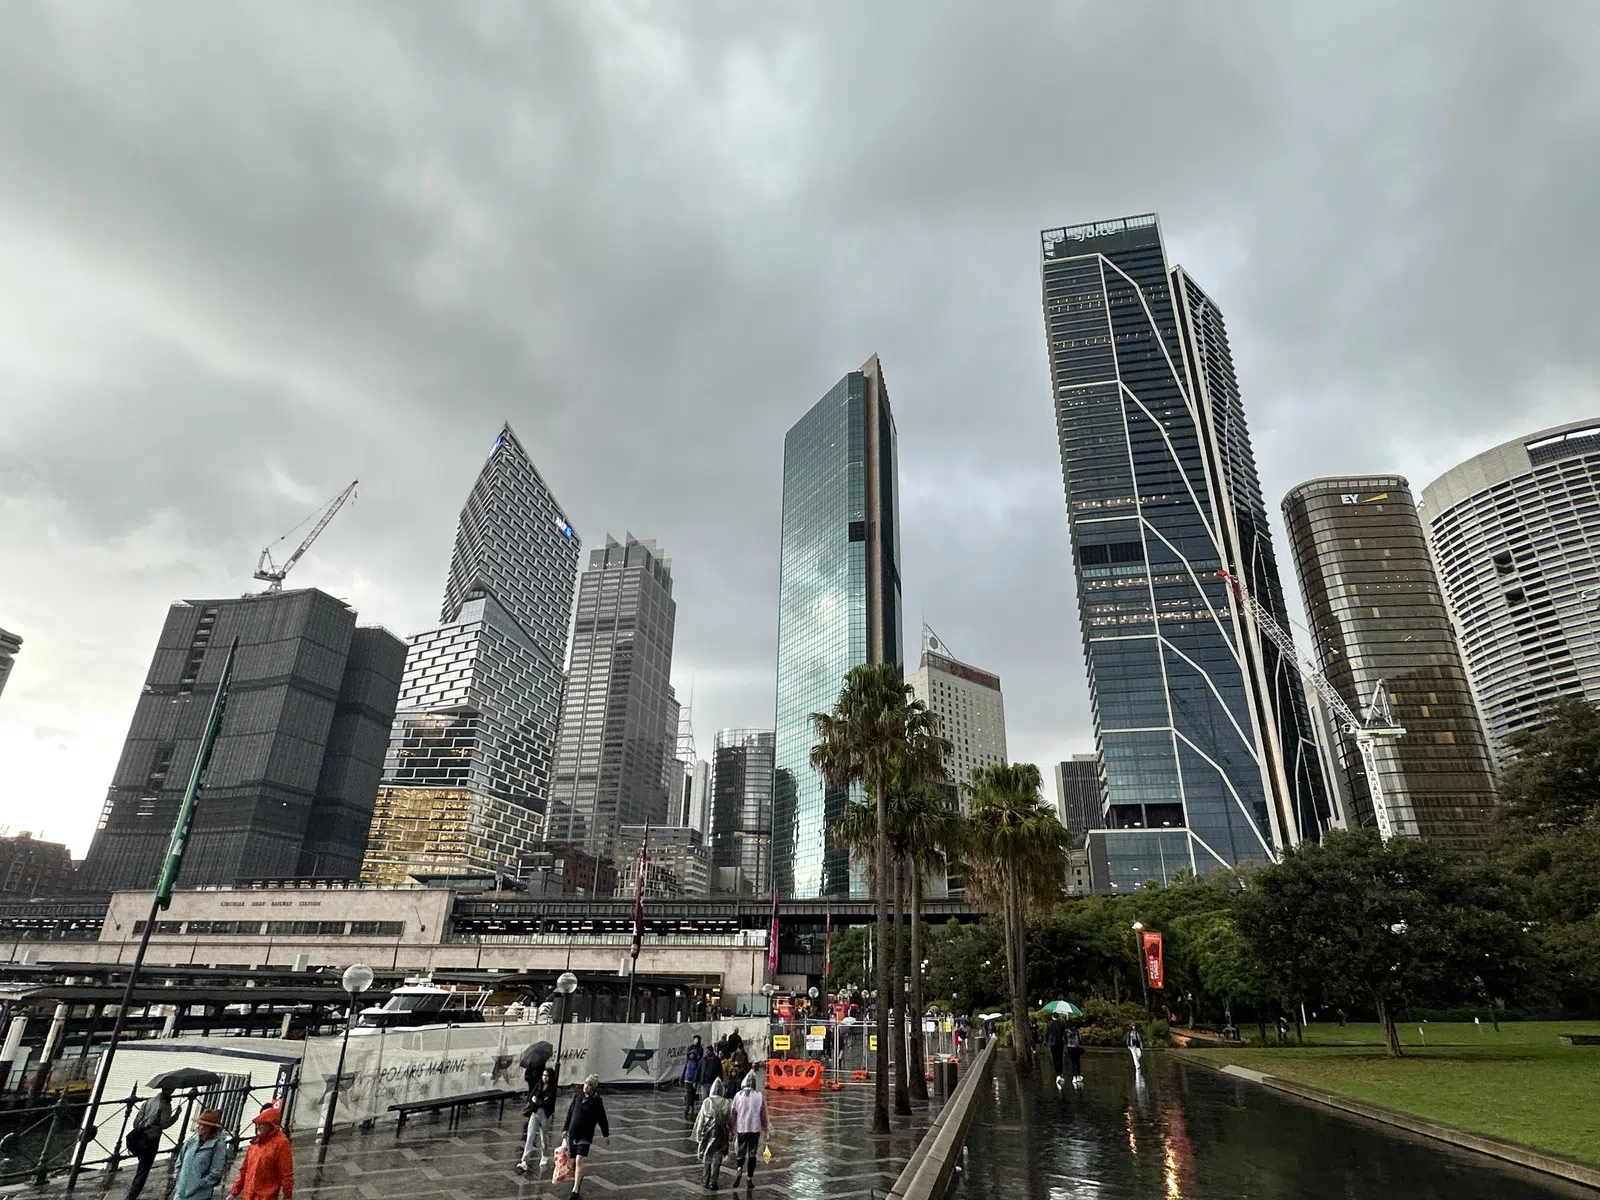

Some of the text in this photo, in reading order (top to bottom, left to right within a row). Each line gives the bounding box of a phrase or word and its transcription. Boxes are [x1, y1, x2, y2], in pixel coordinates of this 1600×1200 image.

[1340, 494, 1359, 504] EY
[380, 1058, 467, 1082] POLARIS MARINE
